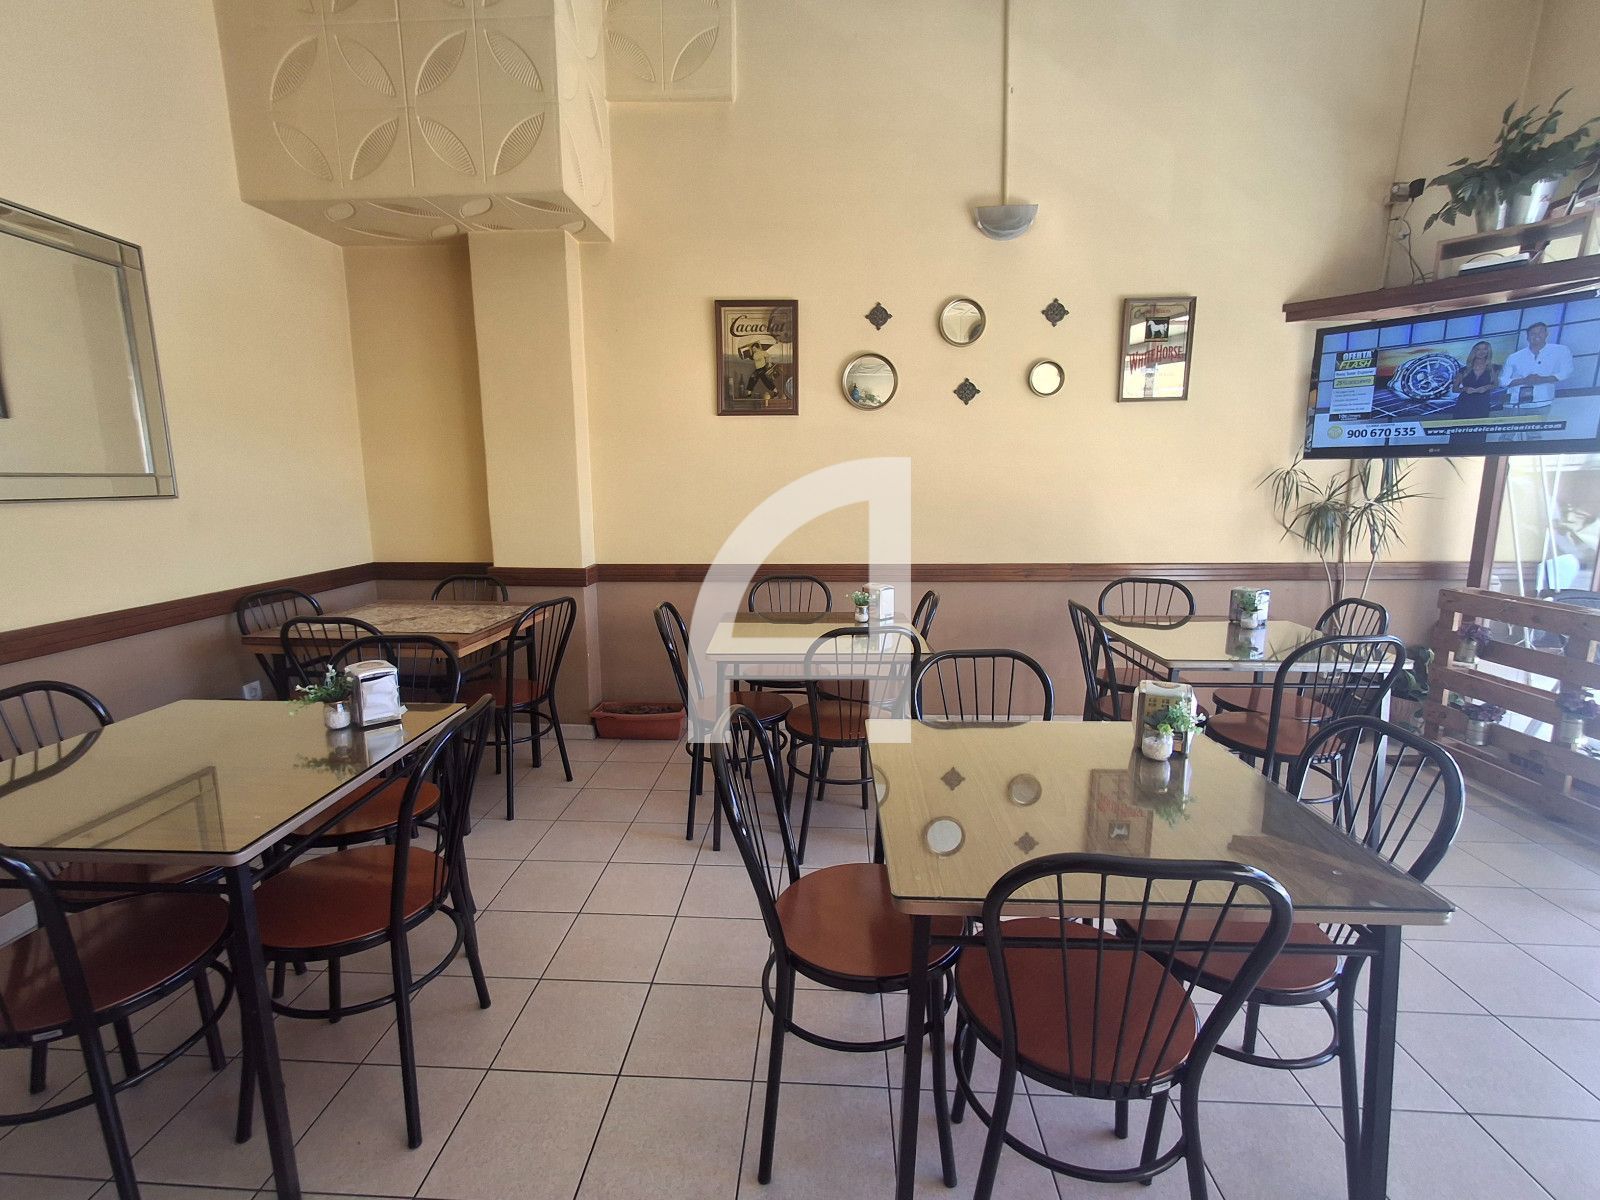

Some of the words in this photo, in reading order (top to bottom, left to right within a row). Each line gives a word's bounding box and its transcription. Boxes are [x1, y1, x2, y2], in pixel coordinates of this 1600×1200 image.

[729, 314, 785, 338] Cacaolat
[1129, 349, 1155, 374] WHITE
[1156, 345, 1184, 362] HORSE
[1343, 351, 1372, 360] OFERTA
[1340, 359, 1372, 370] FLASH
[1347, 429, 1368, 439] 900
[1370, 428, 1392, 438] 670
[1394, 427, 1416, 437] 535
